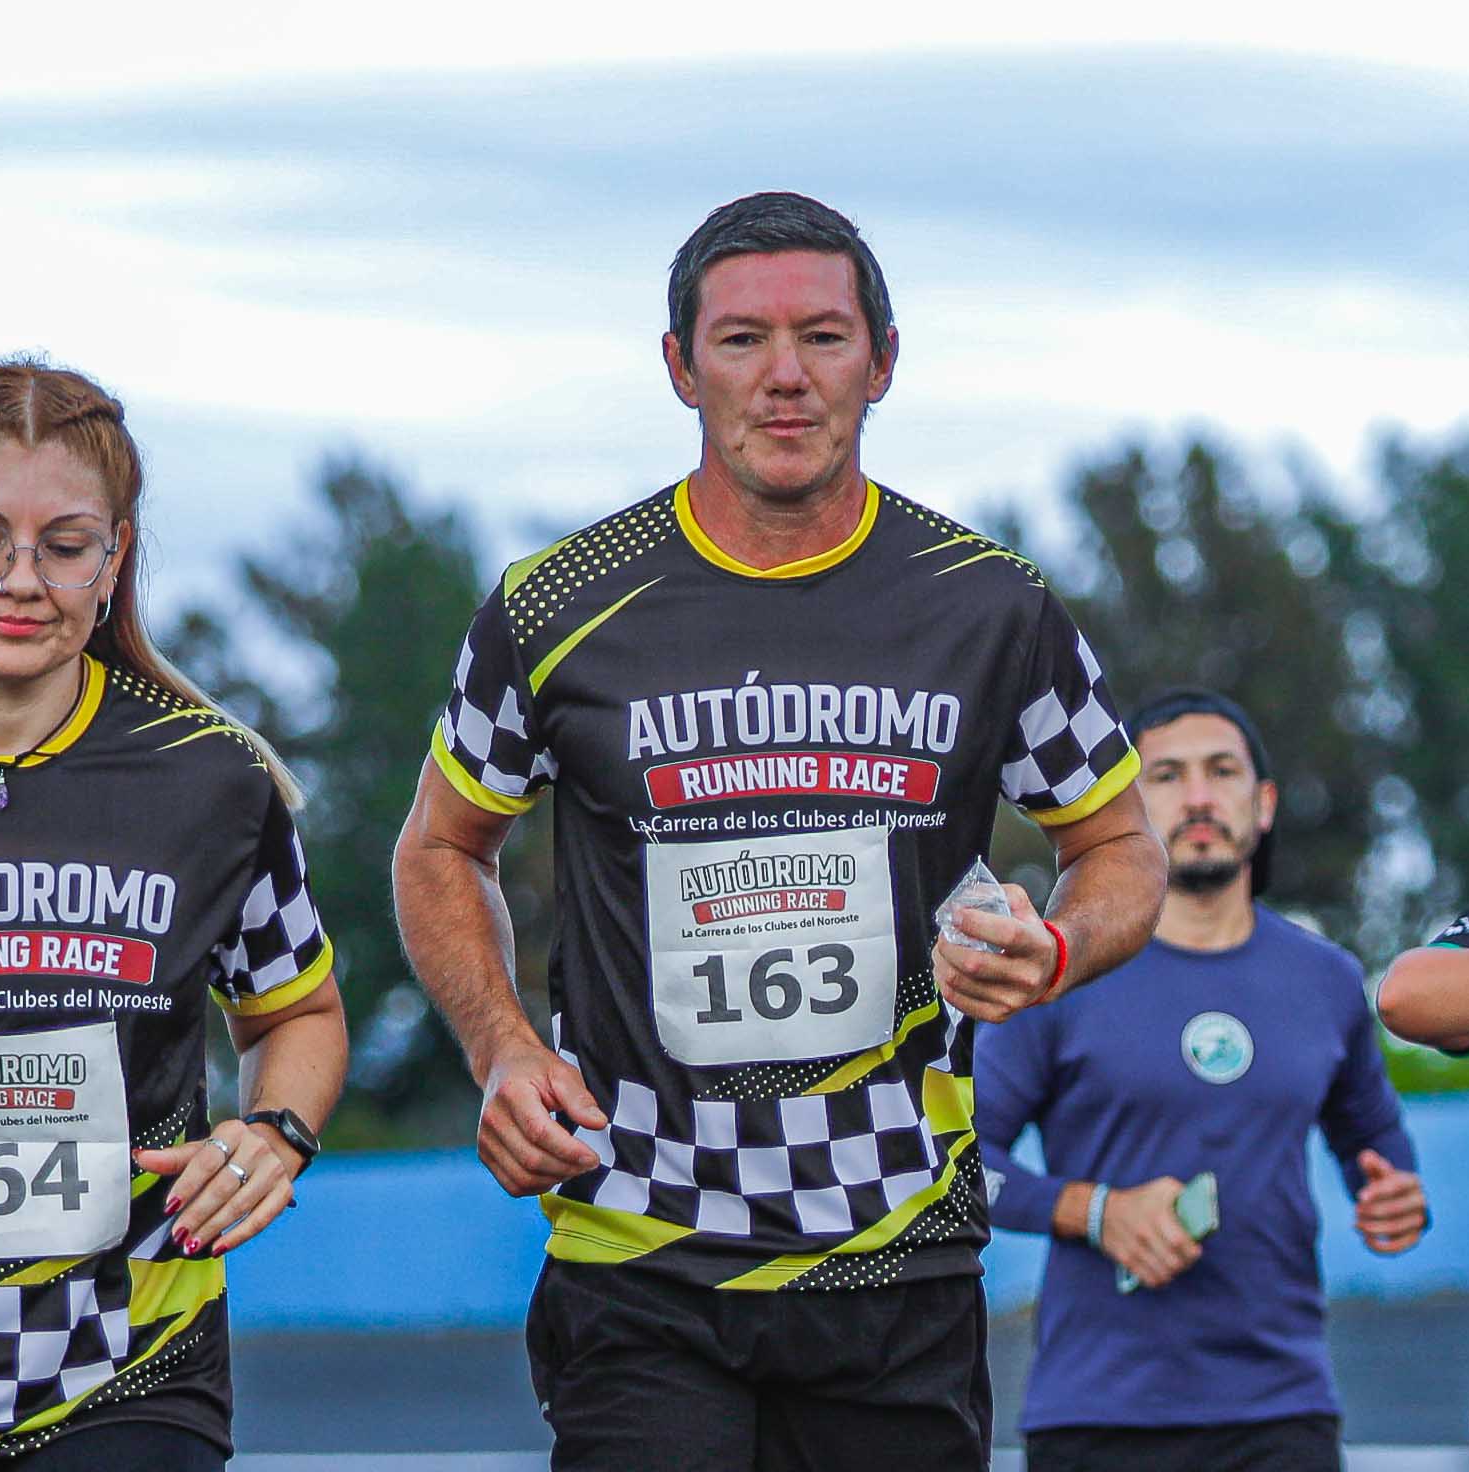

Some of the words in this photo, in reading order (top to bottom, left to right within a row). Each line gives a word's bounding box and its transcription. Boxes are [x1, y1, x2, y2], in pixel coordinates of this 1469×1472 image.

[627, 670, 961, 760] AUTÓDROMO
[679, 756, 819, 800] RUNNING
[829, 757, 909, 796] RACE
[651, 815, 718, 832] Carrera
[724, 811, 746, 830] de
[752, 810, 779, 829] los
[783, 810, 846, 828] Clubes
[852, 809, 880, 828] del
[886, 810, 947, 828] Noroeste
[680, 850, 857, 902] AUTÓDROMO
[709, 892, 782, 920] RUNNING
[786, 891, 828, 909] RACE
[681, 928, 693, 938] La
[694, 928, 731, 938] Carrera
[733, 925, 746, 934] de
[748, 923, 763, 933] los
[764, 920, 798, 931] Clubes
[799, 917, 815, 928] del
[817, 914, 860, 926] Noroeste
[40, 936, 124, 976] RACE
[692, 943, 859, 1024] 163
[63, 988, 92, 1009] del
[98, 989, 172, 1012] Noroeste
[13, 1090, 57, 1108] RACE
[26, 1115, 43, 1125] del
[44, 1113, 89, 1124] Noroeste
